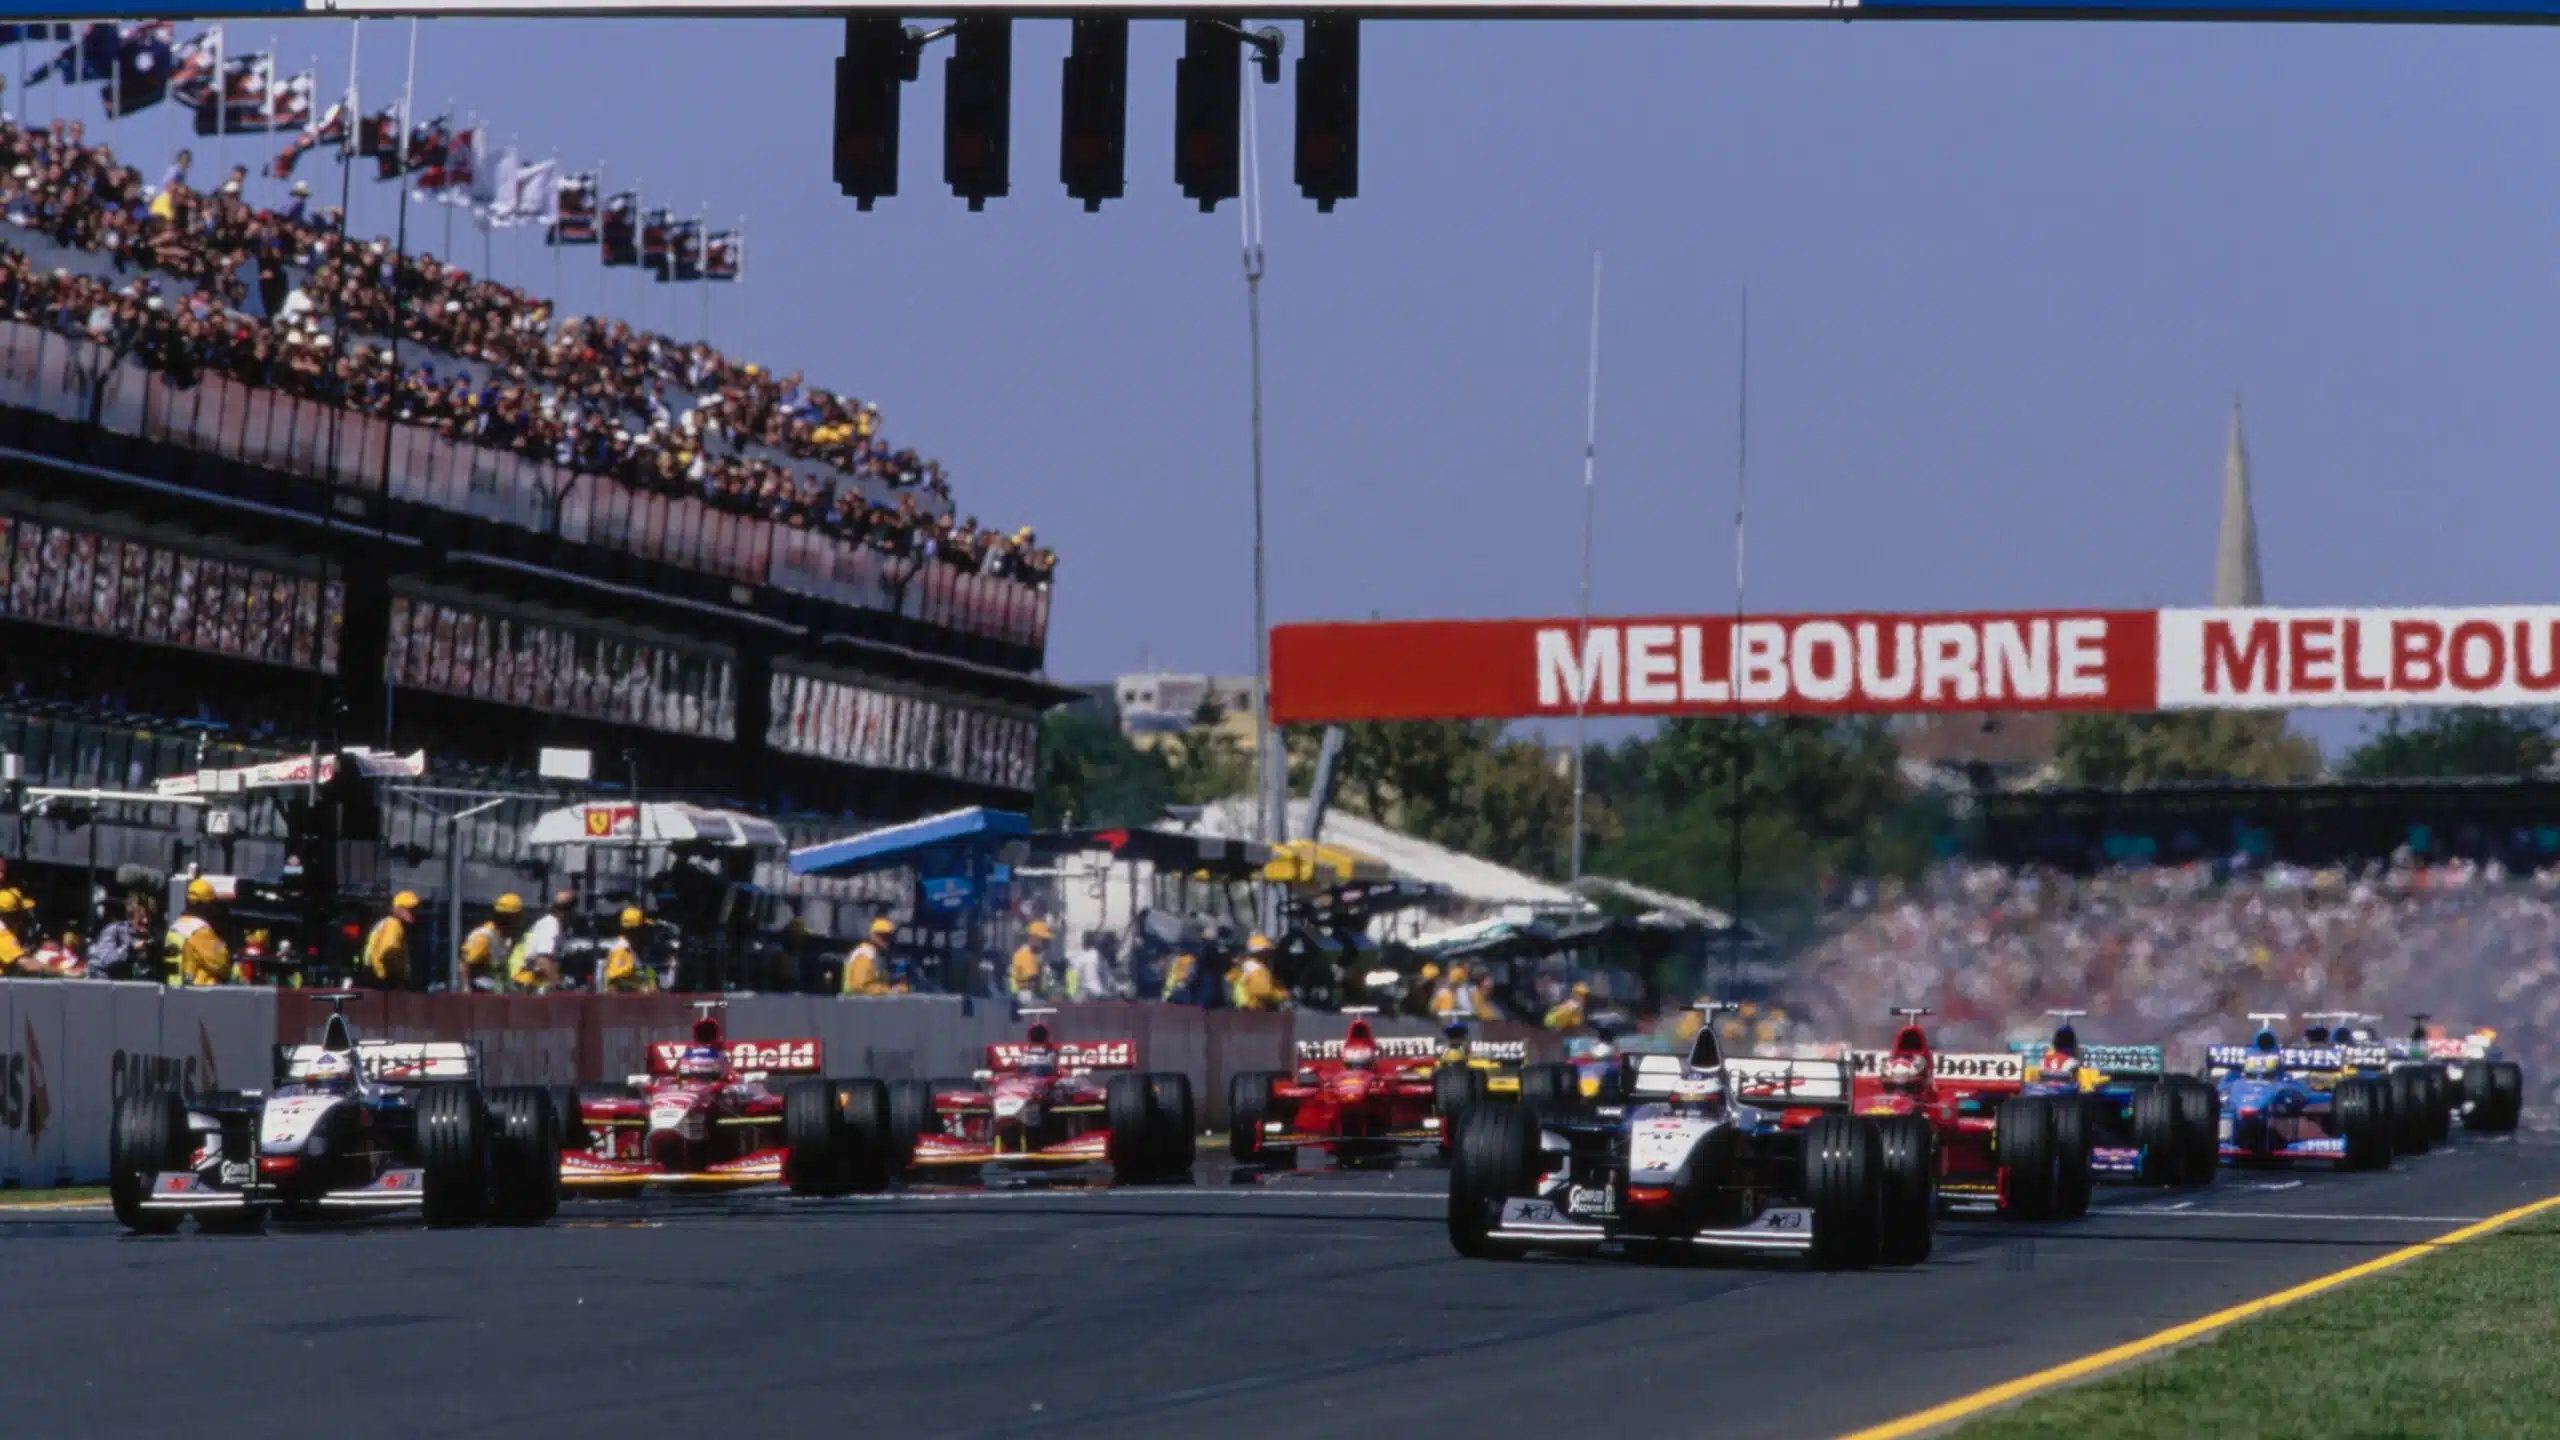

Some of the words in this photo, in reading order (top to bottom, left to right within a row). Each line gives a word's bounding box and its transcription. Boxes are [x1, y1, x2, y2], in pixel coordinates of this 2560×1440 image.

[1535, 617, 2108, 705] MELBOURNE
[2200, 617, 2560, 694] MELBOU
[657, 1043, 814, 1070] Wfield
[995, 1044, 1128, 1066] Wfield
[1851, 1053, 2017, 1077] Mboro
